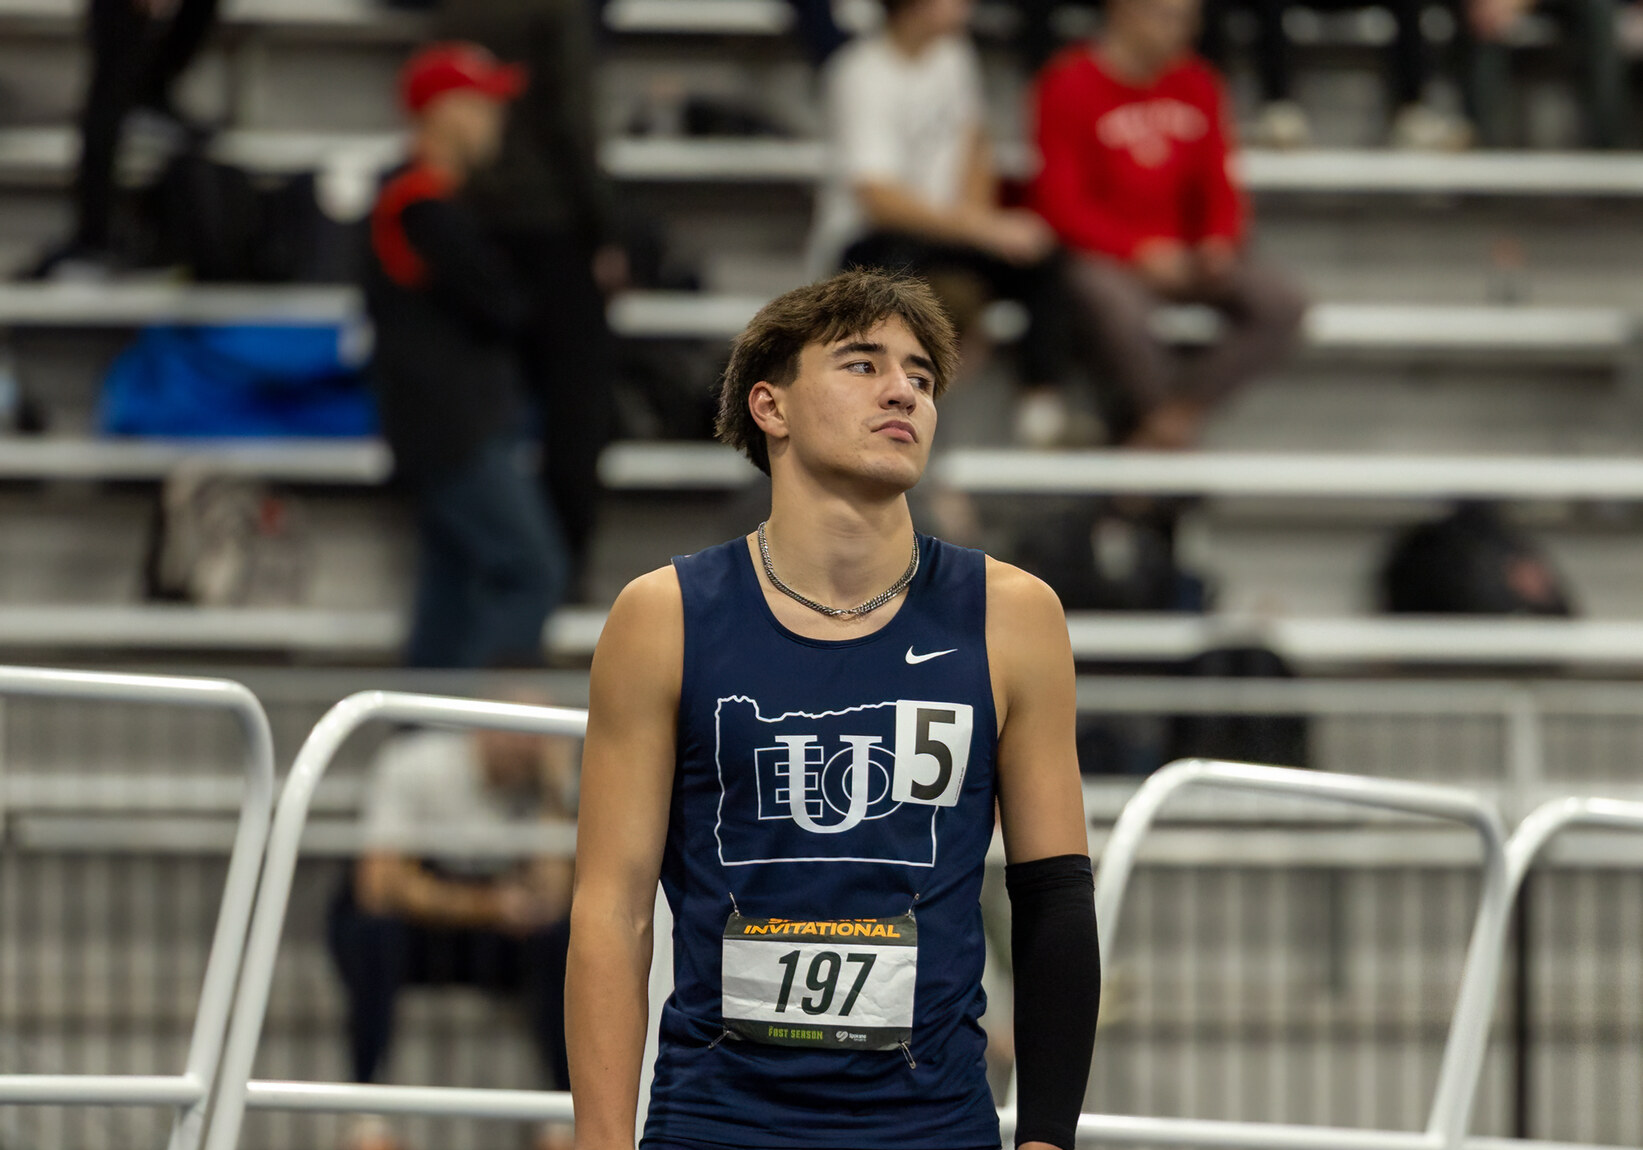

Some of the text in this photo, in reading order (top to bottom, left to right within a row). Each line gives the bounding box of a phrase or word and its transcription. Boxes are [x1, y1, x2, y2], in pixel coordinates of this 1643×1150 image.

[910, 707, 956, 801] 5
[743, 921, 901, 938] INVITATIONAL
[774, 949, 878, 1017] 197
[768, 1025, 823, 1040] FAST SEASON
